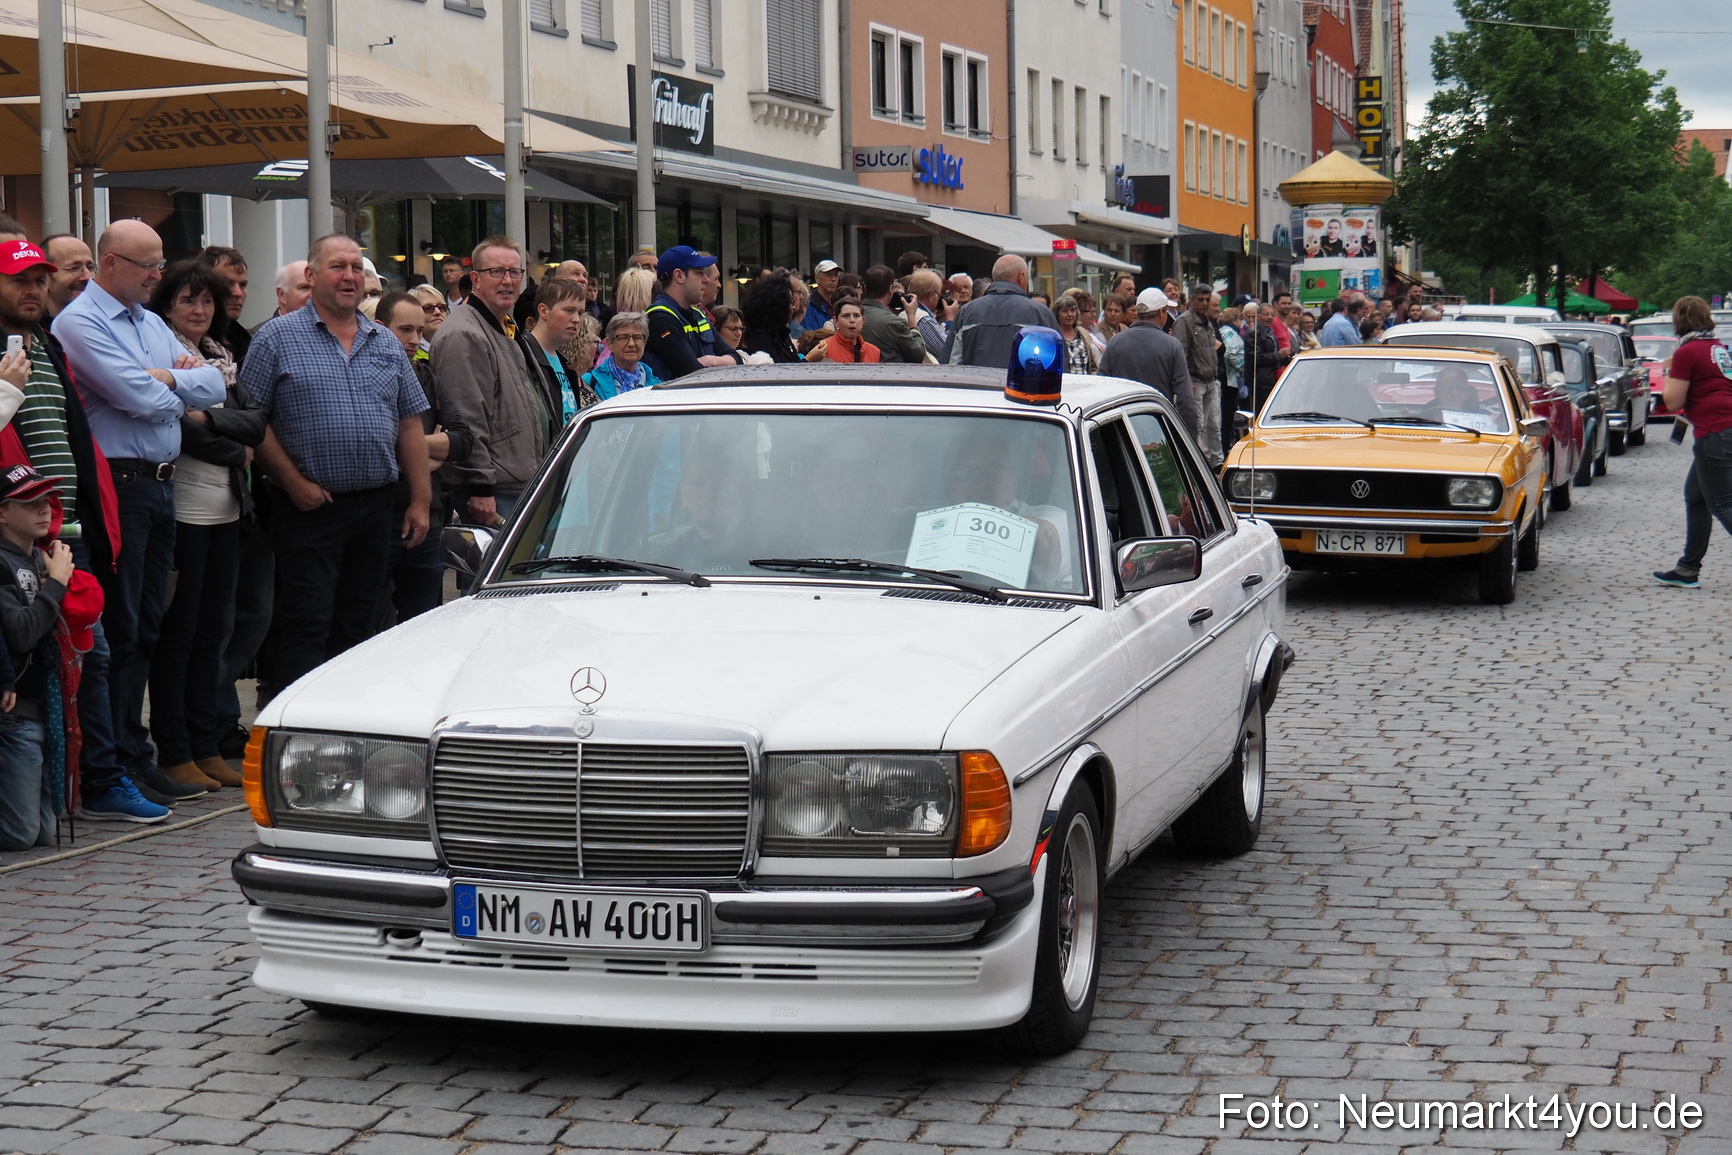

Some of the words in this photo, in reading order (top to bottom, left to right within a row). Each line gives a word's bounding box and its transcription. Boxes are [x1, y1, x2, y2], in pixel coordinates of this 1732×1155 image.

[13, 250, 41, 260] DEKRA
[7, 466, 29, 483] NEW
[969, 517, 1011, 540] 300
[1375, 536, 1403, 552] 871
[462, 915, 471, 927] D
[478, 892, 521, 934] NM
[549, 898, 593, 938] AW
[604, 900, 698, 942] 400H
